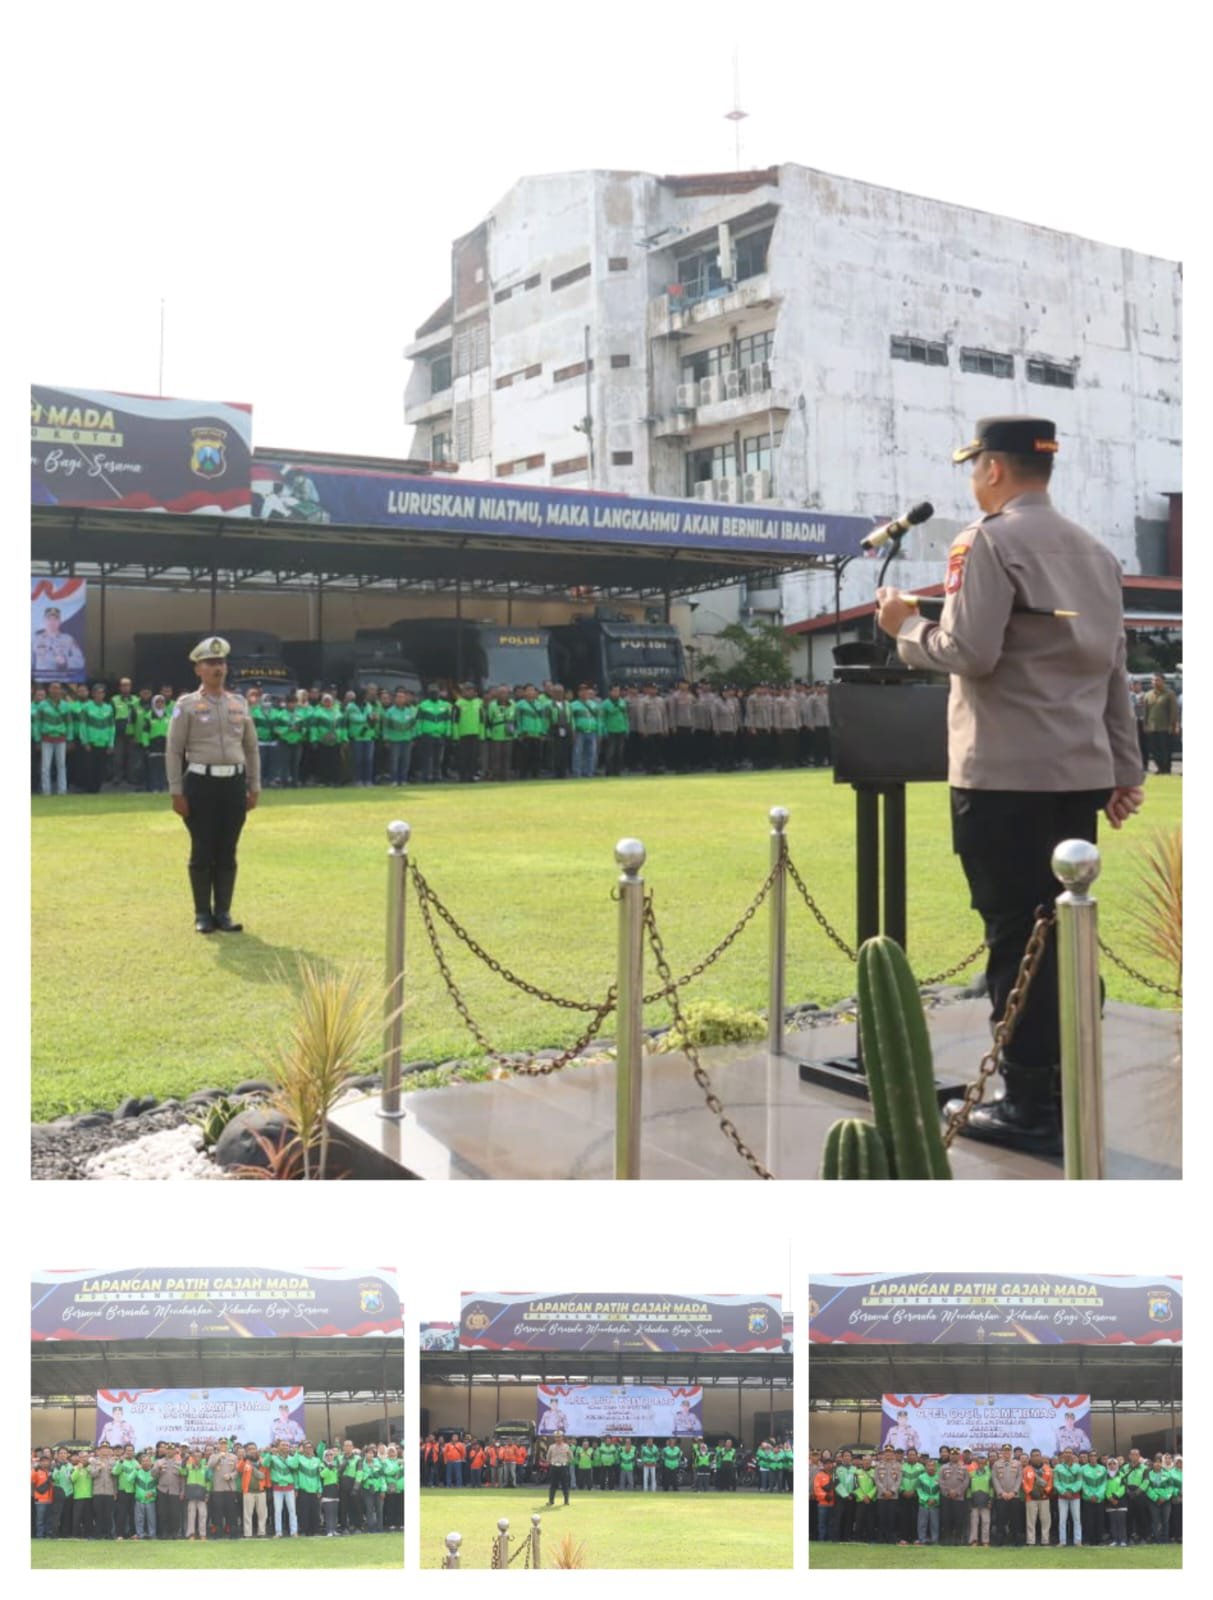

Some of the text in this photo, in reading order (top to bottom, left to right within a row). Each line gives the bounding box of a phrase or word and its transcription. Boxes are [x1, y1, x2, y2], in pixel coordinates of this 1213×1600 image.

[48, 406, 114, 430] MADA
[44, 449, 81, 477] Bagi
[87, 452, 142, 477] Sesama
[387, 490, 827, 543] LURUSKAN NIATMU, MAKA LANGKAHMU AKAN BERNILAI IBADAH
[500, 634, 541, 646] POLISI
[82, 1278, 309, 1292] LAPANGAN PATIH GAJAH MADA
[869, 1283, 1098, 1297] LAPANGAN PATIH GAJAH MADA
[529, 1302, 708, 1313] LAPANGAN PATIH GAJAH MADA
